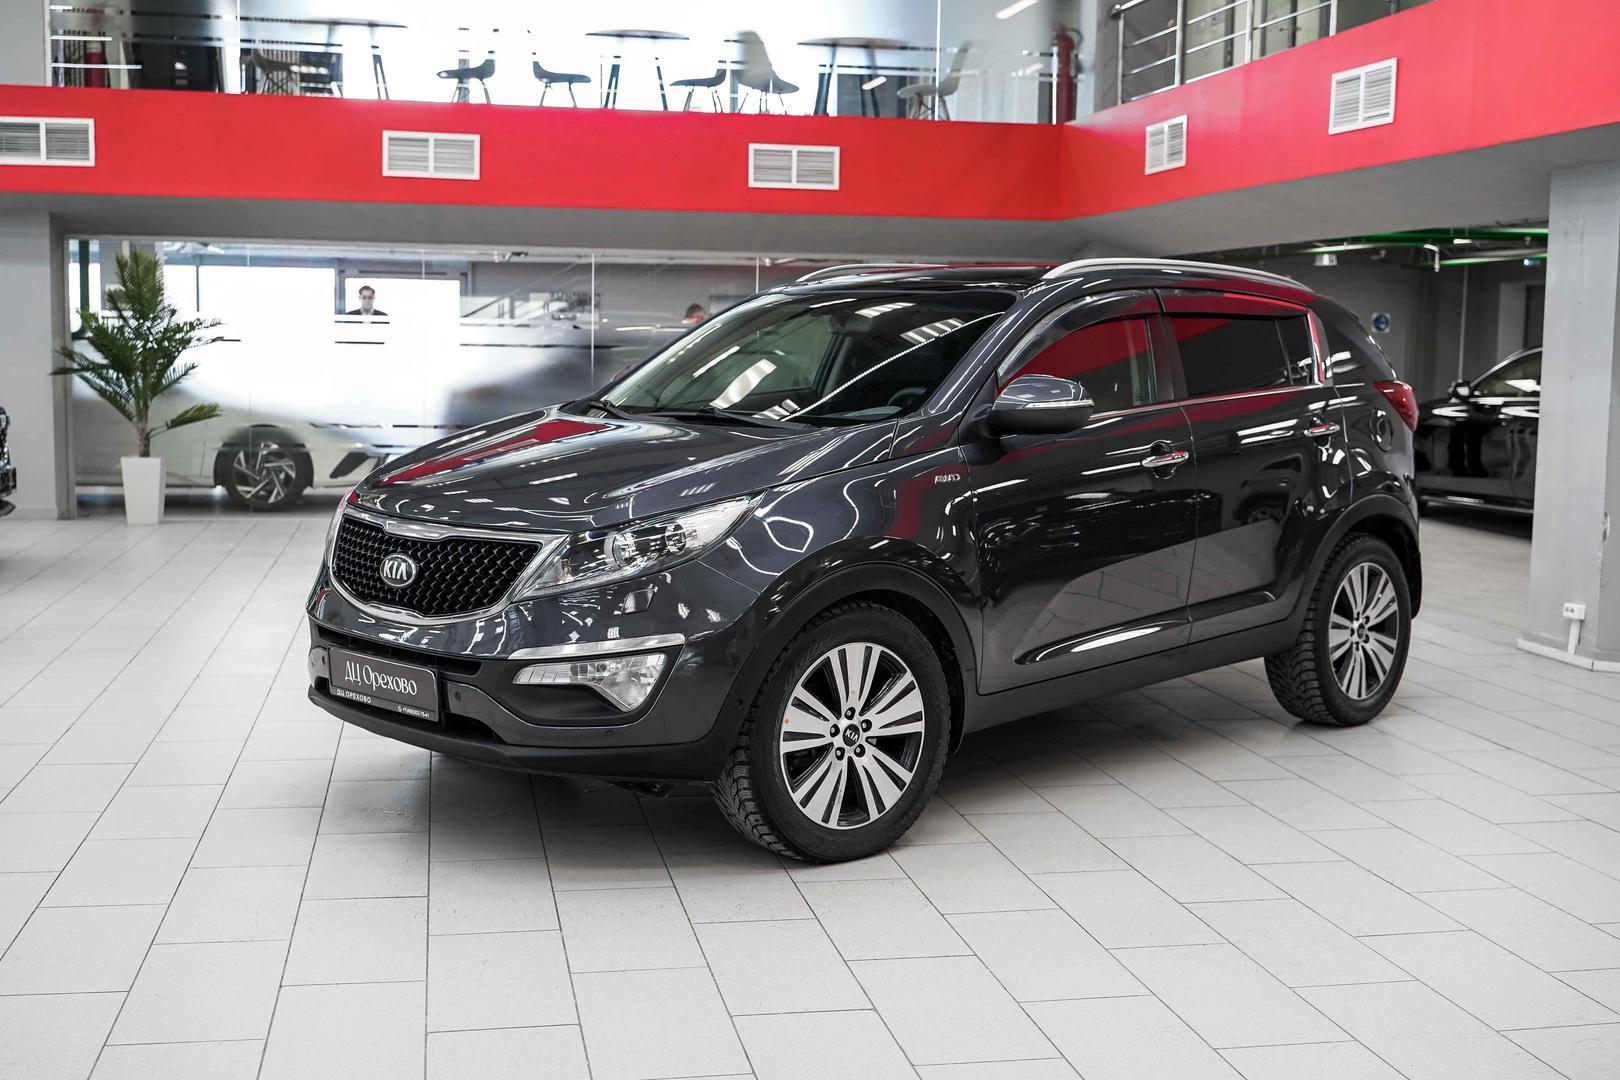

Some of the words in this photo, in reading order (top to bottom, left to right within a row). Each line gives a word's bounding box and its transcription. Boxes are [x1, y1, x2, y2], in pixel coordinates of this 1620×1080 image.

[934, 473, 961, 484] AWD
[384, 560, 407, 580] KIA
[345, 660, 362, 686] ДЦ
[362, 665, 417, 695] Орехово
[345, 691, 372, 704] ОРЕХОВО
[845, 728, 859, 742] KIA
